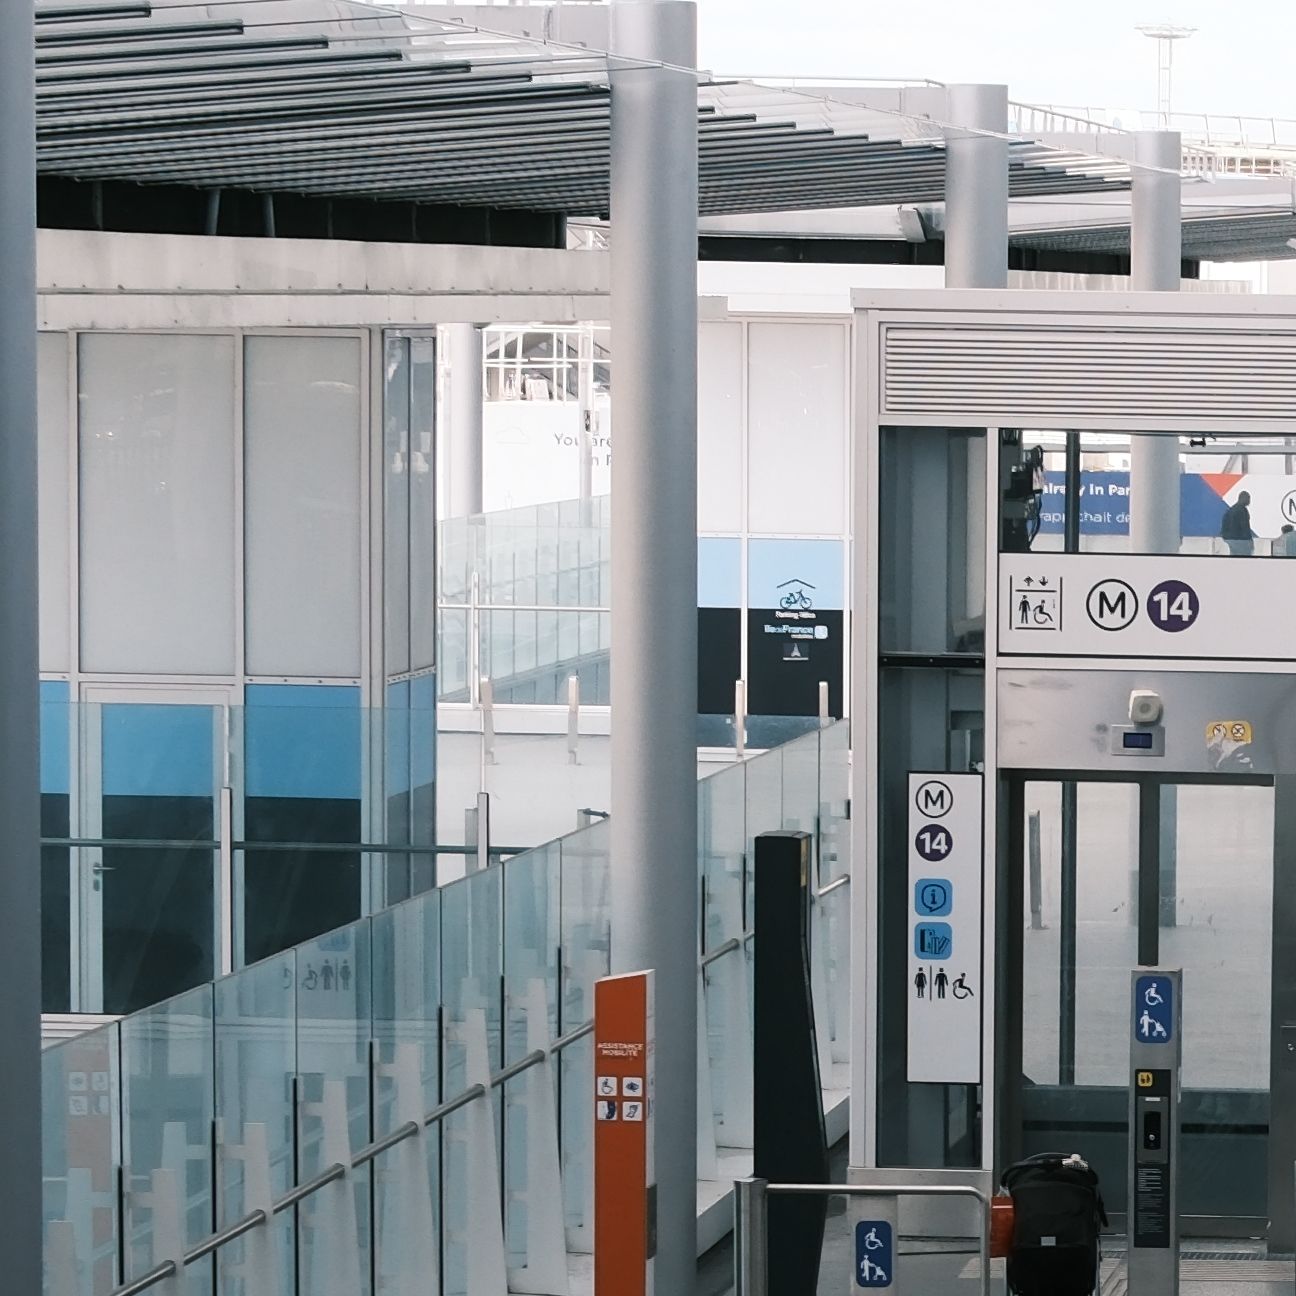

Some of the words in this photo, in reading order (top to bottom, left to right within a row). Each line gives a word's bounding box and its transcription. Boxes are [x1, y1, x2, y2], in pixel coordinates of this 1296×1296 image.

[1108, 485, 1131, 496] Par
[1099, 590, 1126, 619] M
[1152, 591, 1193, 621] 14
[924, 789, 945, 810] M
[919, 831, 949, 855] 14
